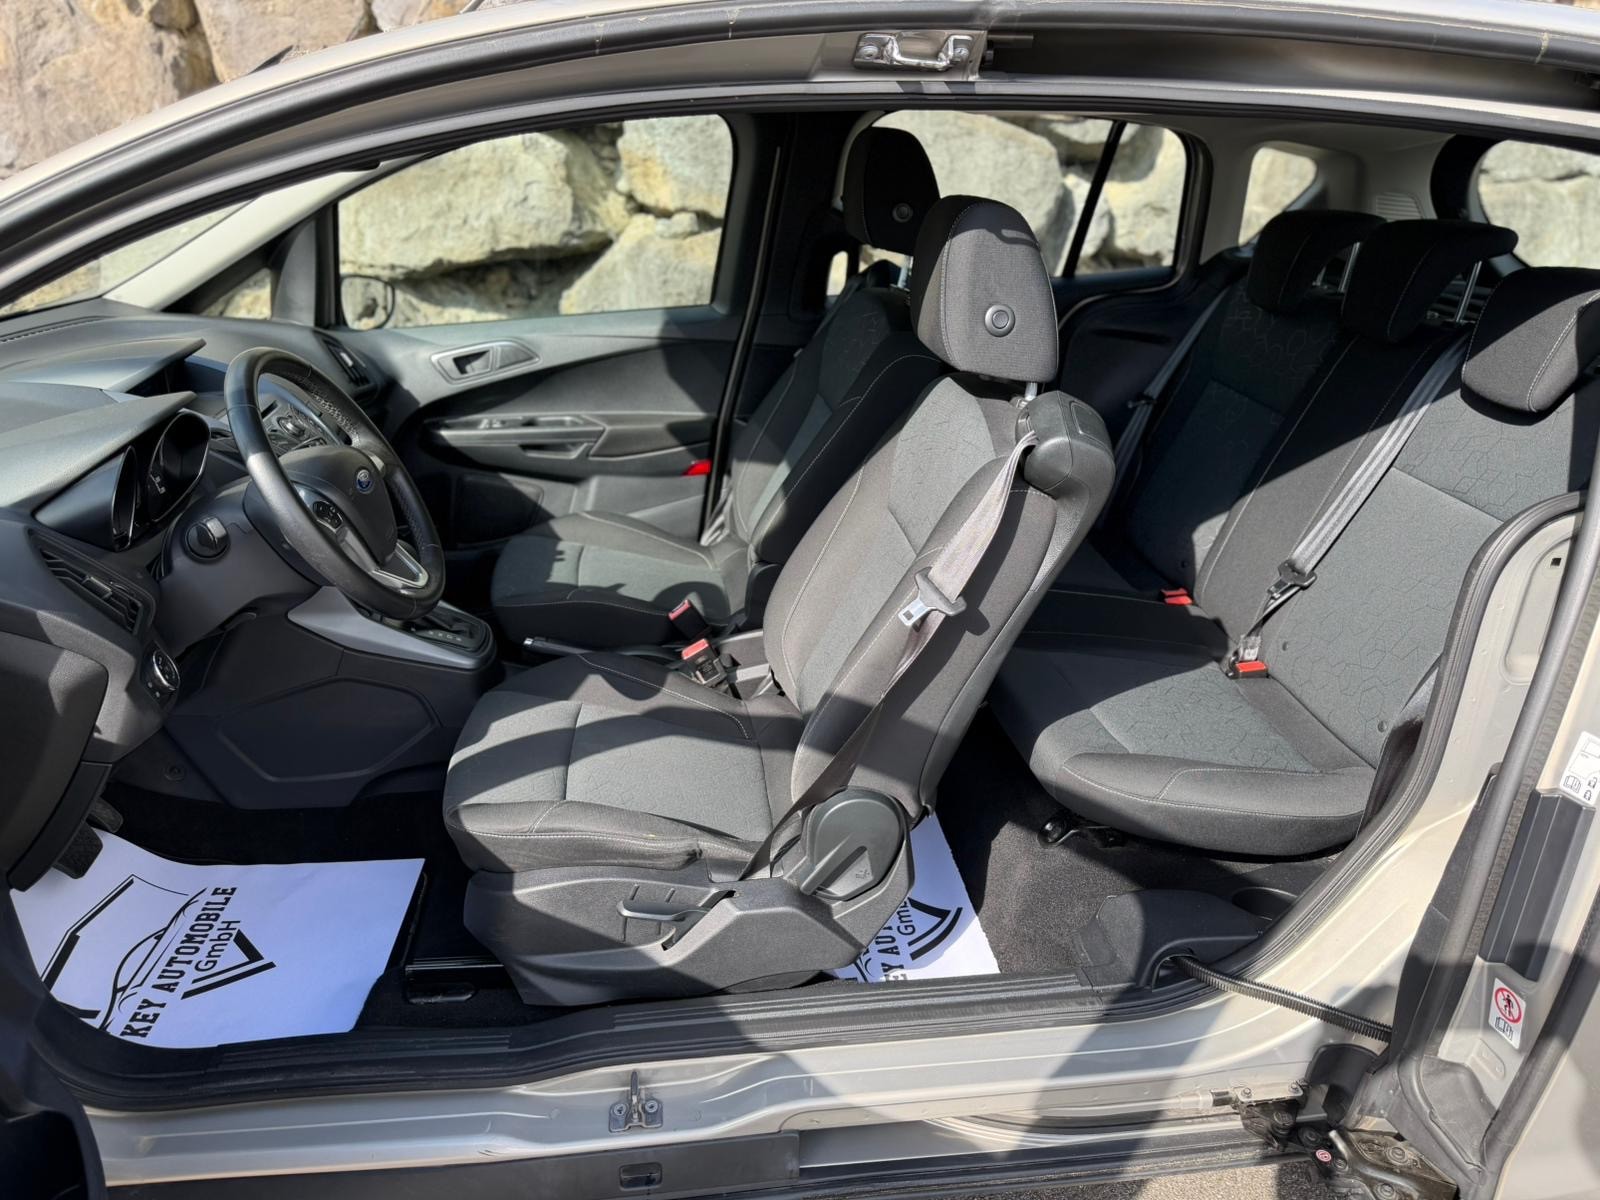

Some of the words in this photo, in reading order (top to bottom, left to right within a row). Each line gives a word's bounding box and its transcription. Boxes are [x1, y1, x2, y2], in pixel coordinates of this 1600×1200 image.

[119, 998, 167, 1038] KEY
[151, 886, 238, 994] AUTOMOBILE
[194, 919, 241, 972] GmbH
